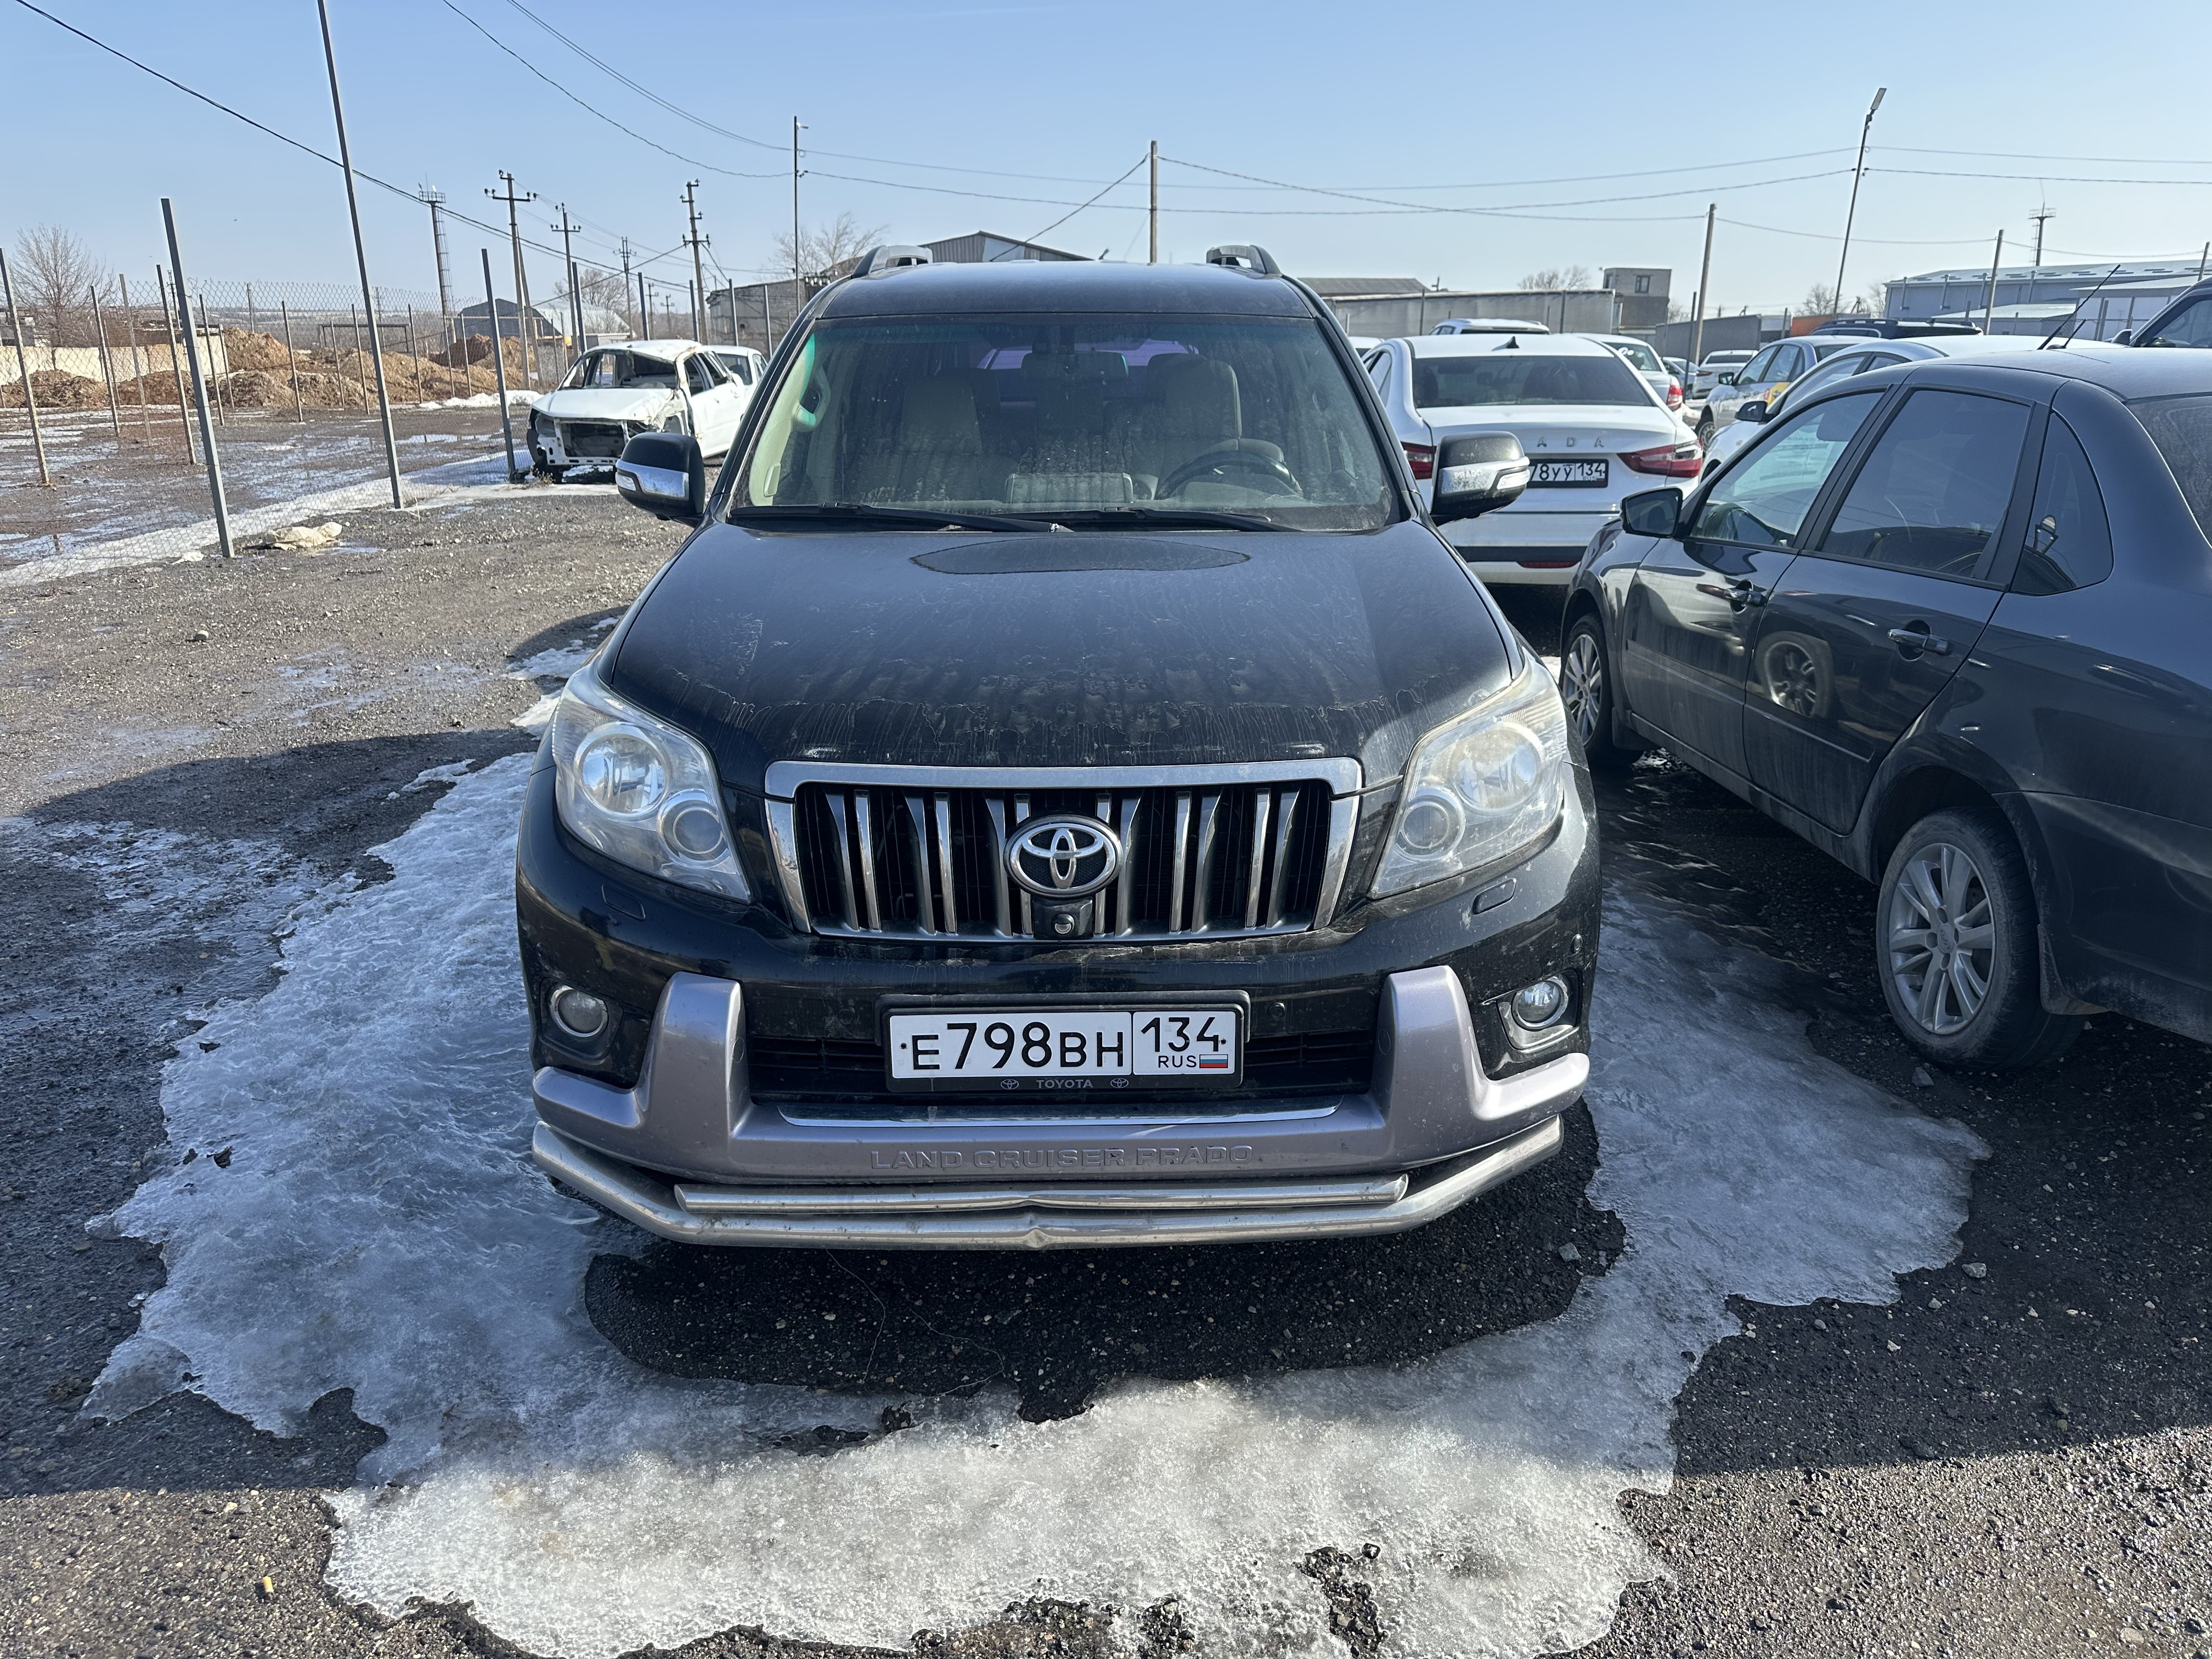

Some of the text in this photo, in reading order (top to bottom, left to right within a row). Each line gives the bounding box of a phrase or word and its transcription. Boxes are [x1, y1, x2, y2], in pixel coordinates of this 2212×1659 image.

[1537, 437, 1605, 448] ADA
[1577, 463, 1602, 476] 134
[1140, 1016, 1220, 1053] 134
[1158, 1054, 1197, 1069] RUS
[1036, 1079, 1094, 1090] TOYOTA
[870, 1144, 1253, 1169] LAND CRUISER PRADO
